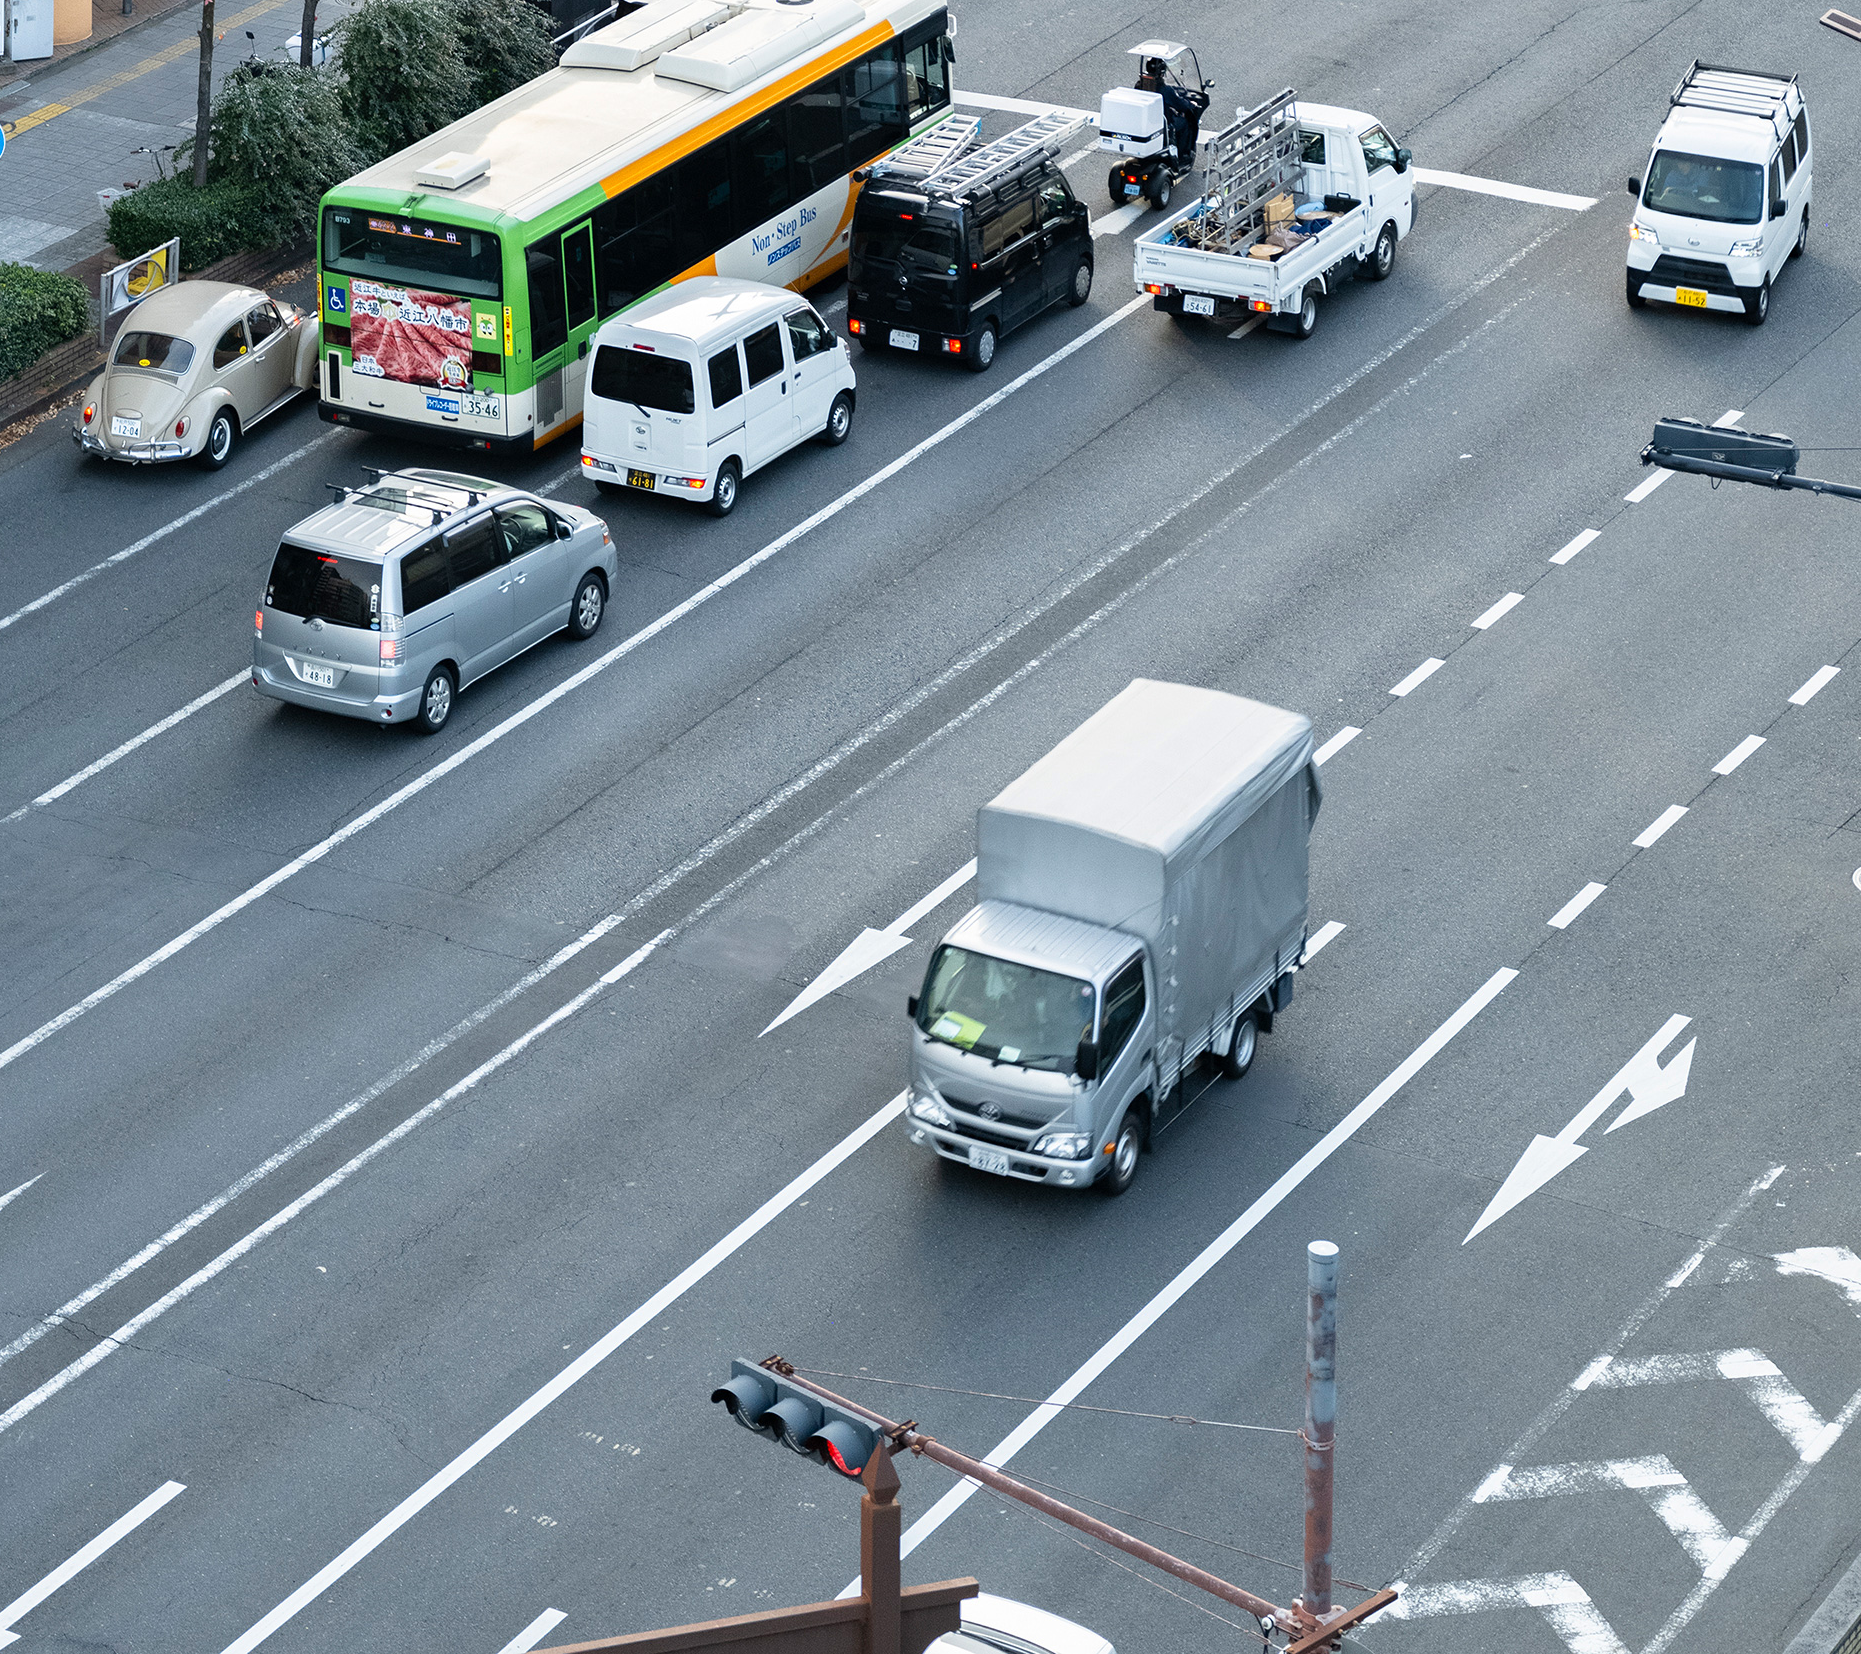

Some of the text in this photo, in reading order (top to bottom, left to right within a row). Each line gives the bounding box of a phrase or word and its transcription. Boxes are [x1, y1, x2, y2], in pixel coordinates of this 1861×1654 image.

[800, 206, 817, 228] Bus
[354, 299, 468, 331] 本場 近江八幡市
[1190, 303, 1212, 314] 54-61
[361, 356, 375, 364] 日本
[469, 400, 498, 417] 35-46
[632, 476, 654, 489] 61-81
[309, 670, 332, 685] 48-18
